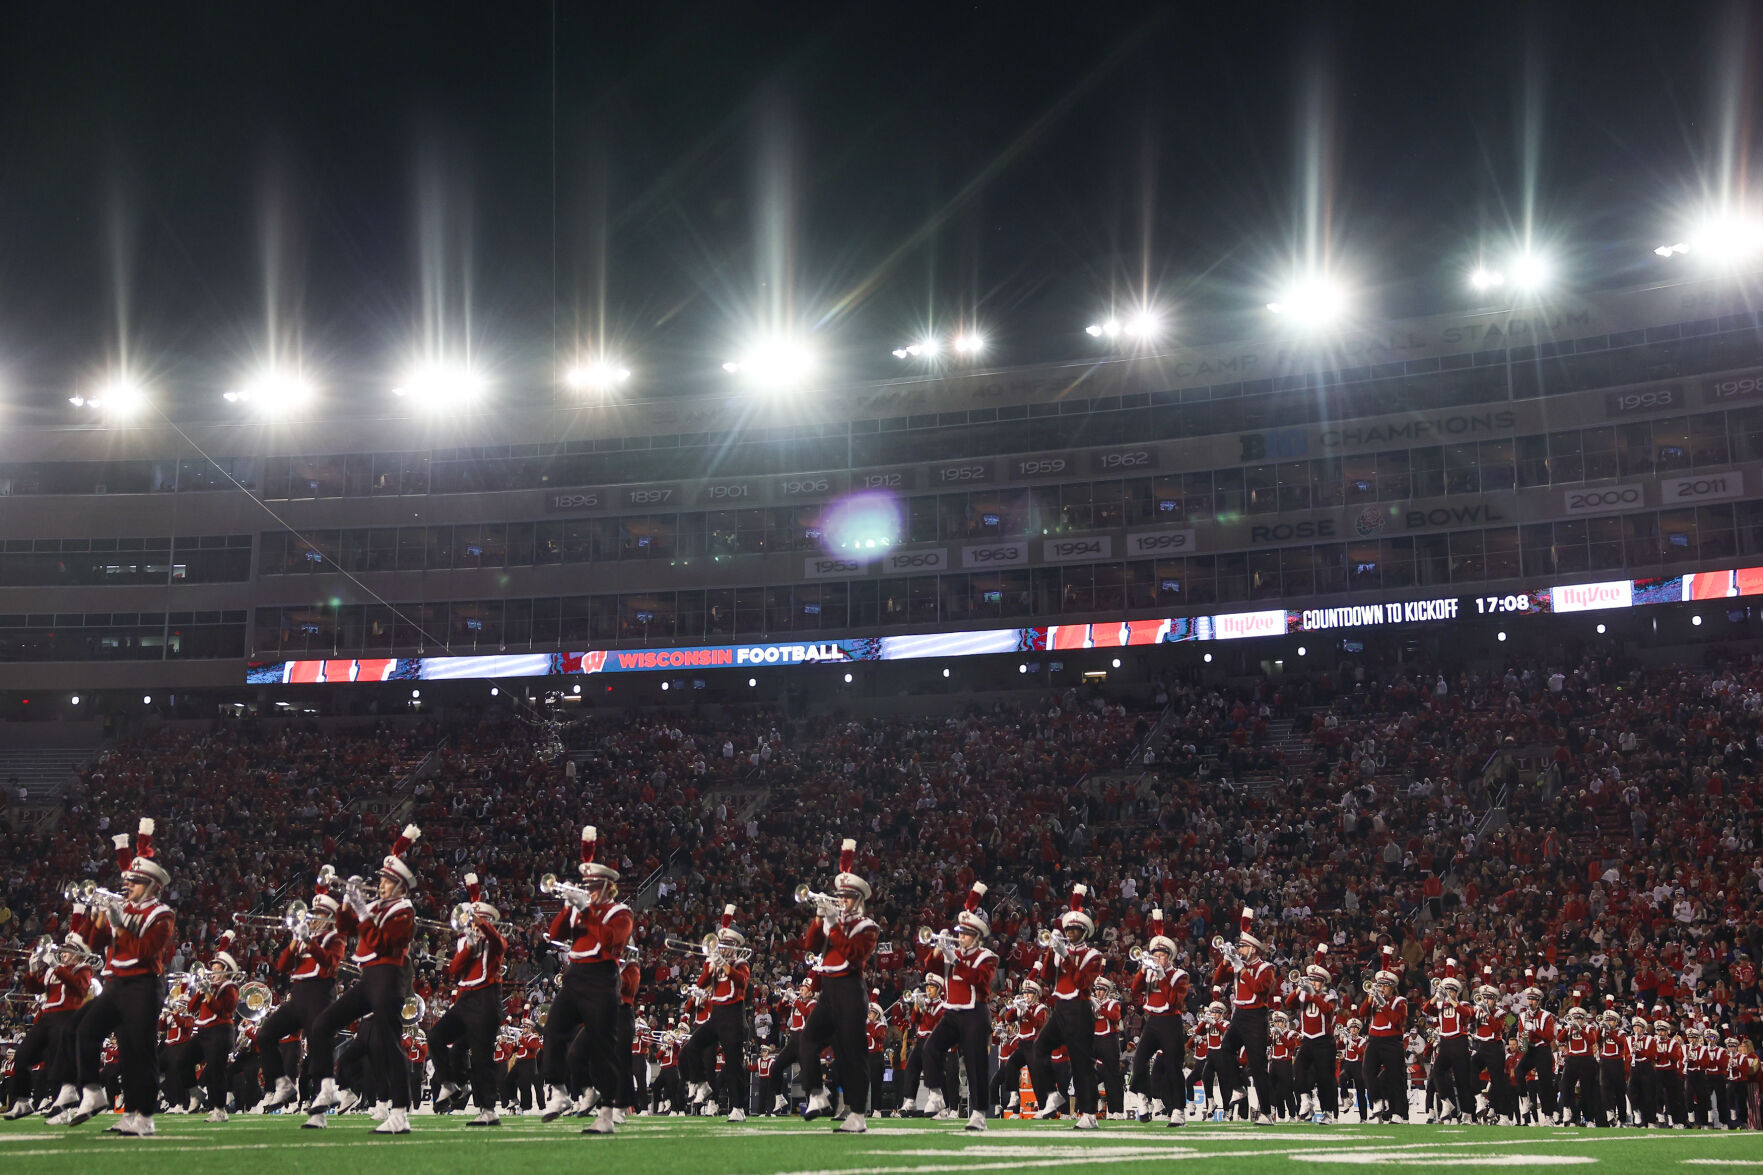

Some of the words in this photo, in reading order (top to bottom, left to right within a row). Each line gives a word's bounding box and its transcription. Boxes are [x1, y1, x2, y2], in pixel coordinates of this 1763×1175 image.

[1176, 354, 1257, 378] CAMP
[1620, 390, 1673, 410] 1993
[1319, 411, 1517, 448] CHAMPIONS
[1019, 458, 1067, 474] 1959
[1101, 452, 1149, 467] 1962
[864, 473, 902, 488] 1912
[940, 466, 985, 481] 1952
[708, 485, 749, 498] 1901
[781, 479, 829, 494] 1906
[1678, 478, 1727, 497] 2011
[554, 494, 598, 508] 1896
[629, 489, 673, 504] 1897
[1570, 489, 1639, 509] 2000
[1251, 519, 1336, 543] ROSE
[1405, 504, 1504, 529] BOWL
[1053, 541, 1101, 557] 1994
[1136, 534, 1186, 550] 1999
[892, 553, 940, 568] 1960
[972, 547, 1019, 562] 1963
[814, 559, 858, 574] 1953
[1302, 604, 1384, 630] COUNTDOWN
[1385, 603, 1402, 623] TO
[1404, 598, 1459, 621] KICKOFF
[1475, 594, 1529, 614] 17:08
[618, 649, 733, 669] WISCONSIN
[737, 644, 843, 664] FOOTBALL
